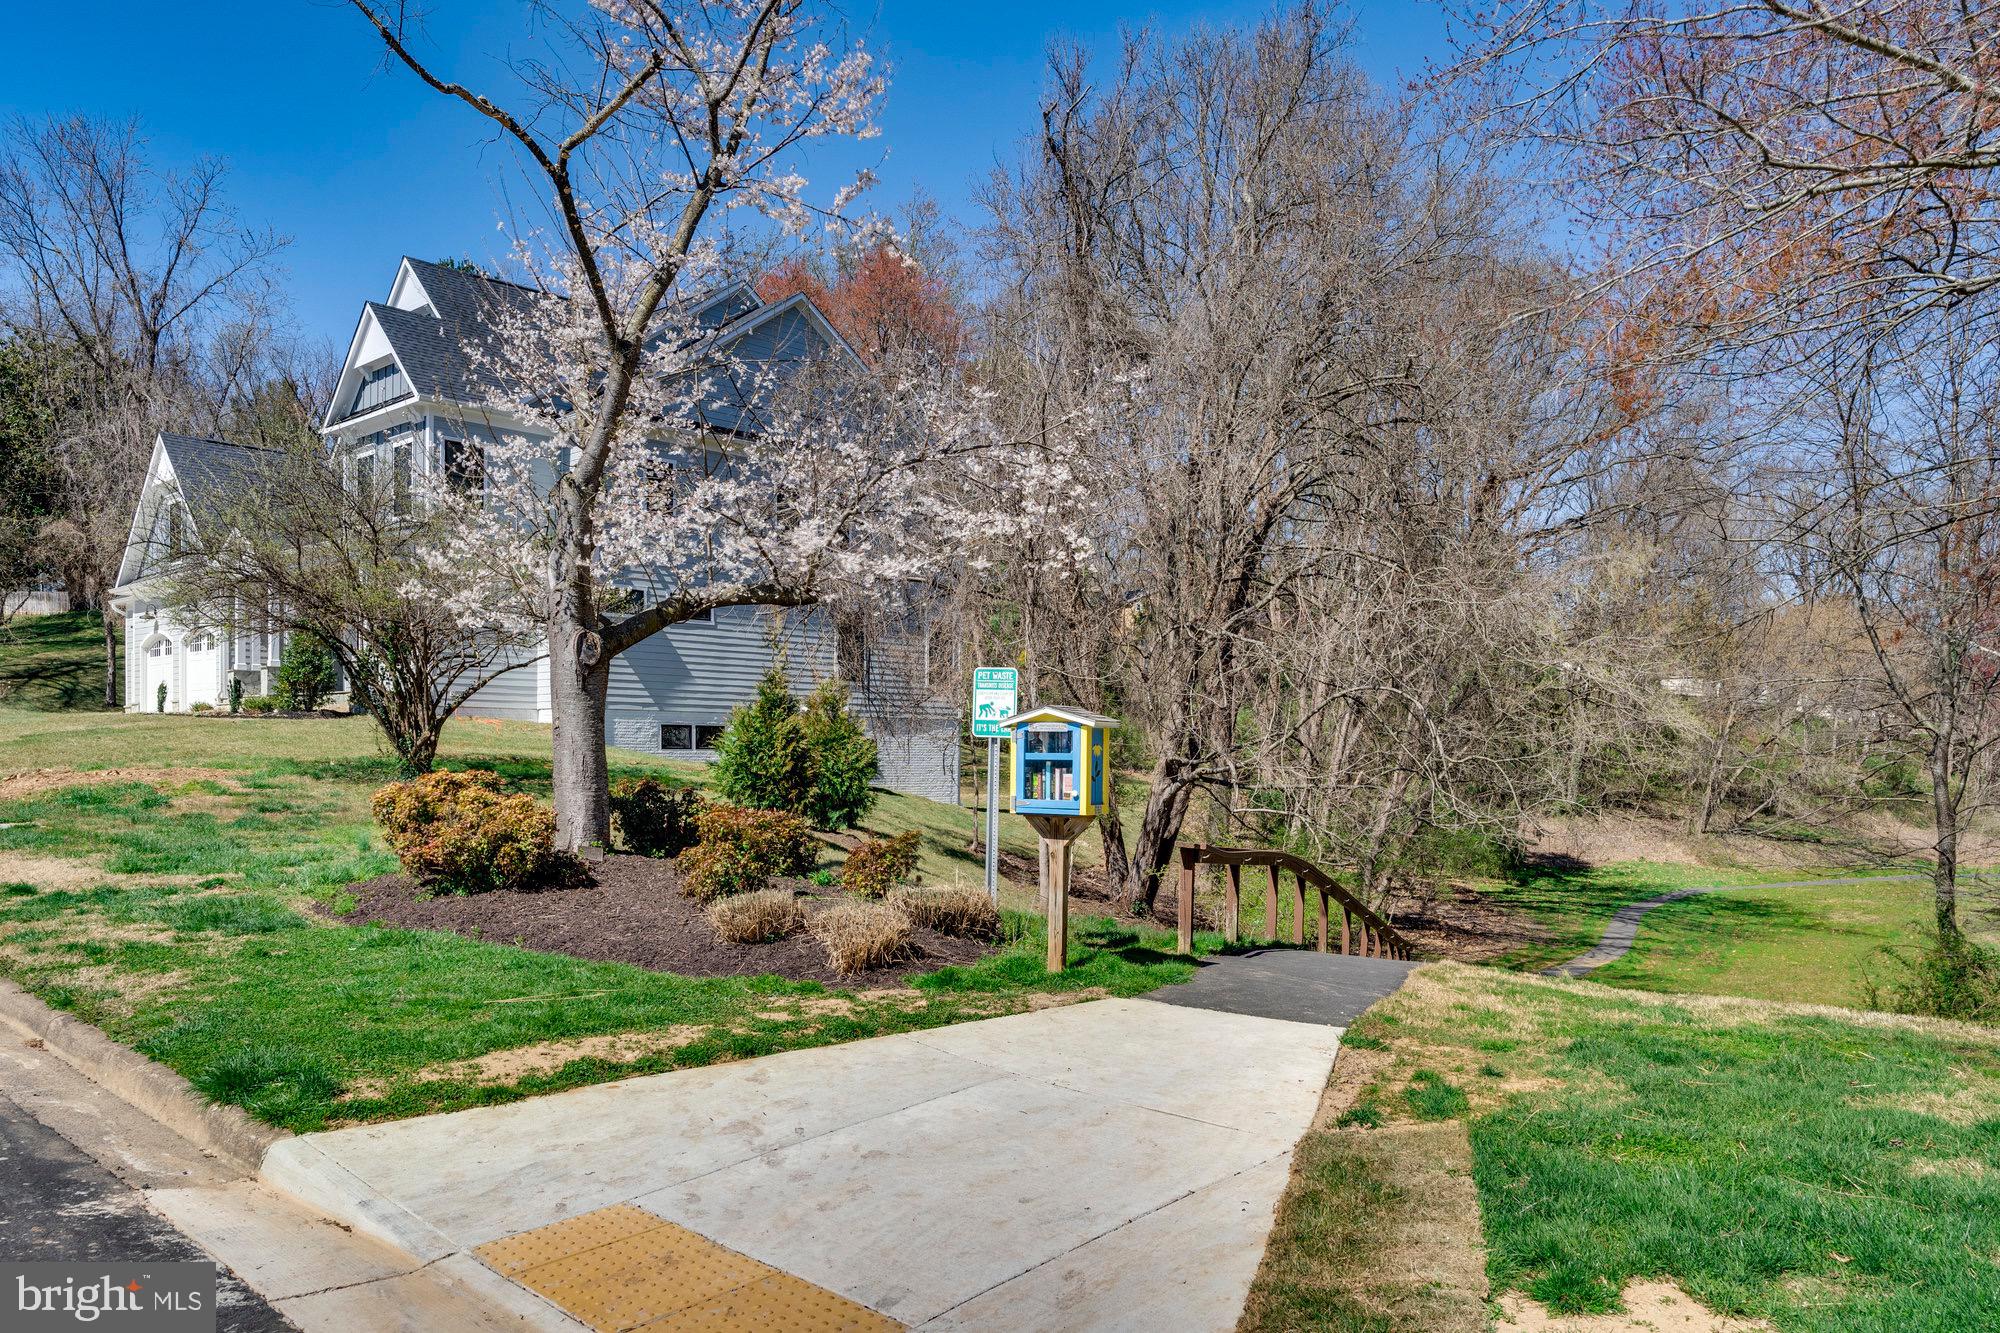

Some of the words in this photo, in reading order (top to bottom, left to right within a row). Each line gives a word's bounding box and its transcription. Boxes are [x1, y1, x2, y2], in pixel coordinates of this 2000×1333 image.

[978, 671, 990, 680] PET
[992, 671, 1014, 680] WASTE
[988, 724, 999, 732] THE
